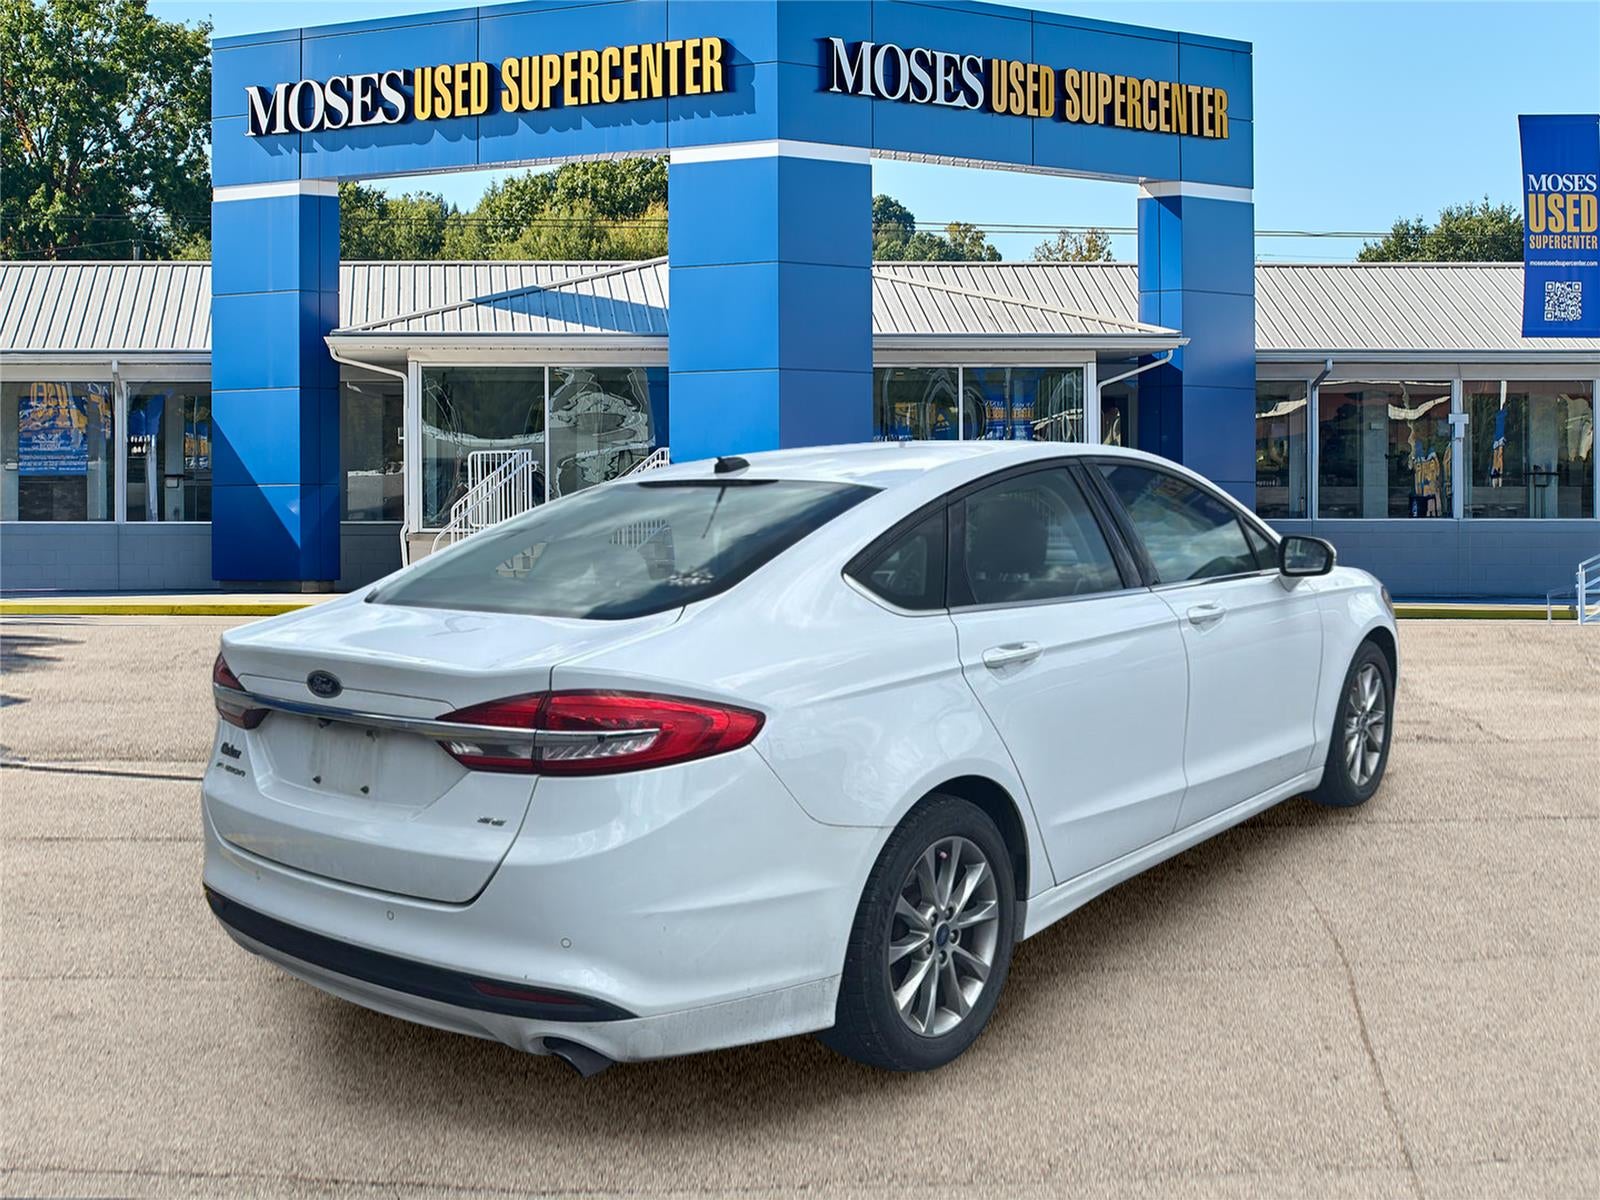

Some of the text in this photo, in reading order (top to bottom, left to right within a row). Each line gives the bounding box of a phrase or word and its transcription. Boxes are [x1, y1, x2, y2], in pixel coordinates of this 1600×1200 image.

[244, 37, 724, 137] MOSES USED SUPERCENTER
[829, 37, 1229, 139] MOSES USED SUPERCENTER
[1528, 174, 1597, 192] MOSES
[1528, 194, 1598, 233] USED
[1529, 235, 1598, 249] SUPERCENTER
